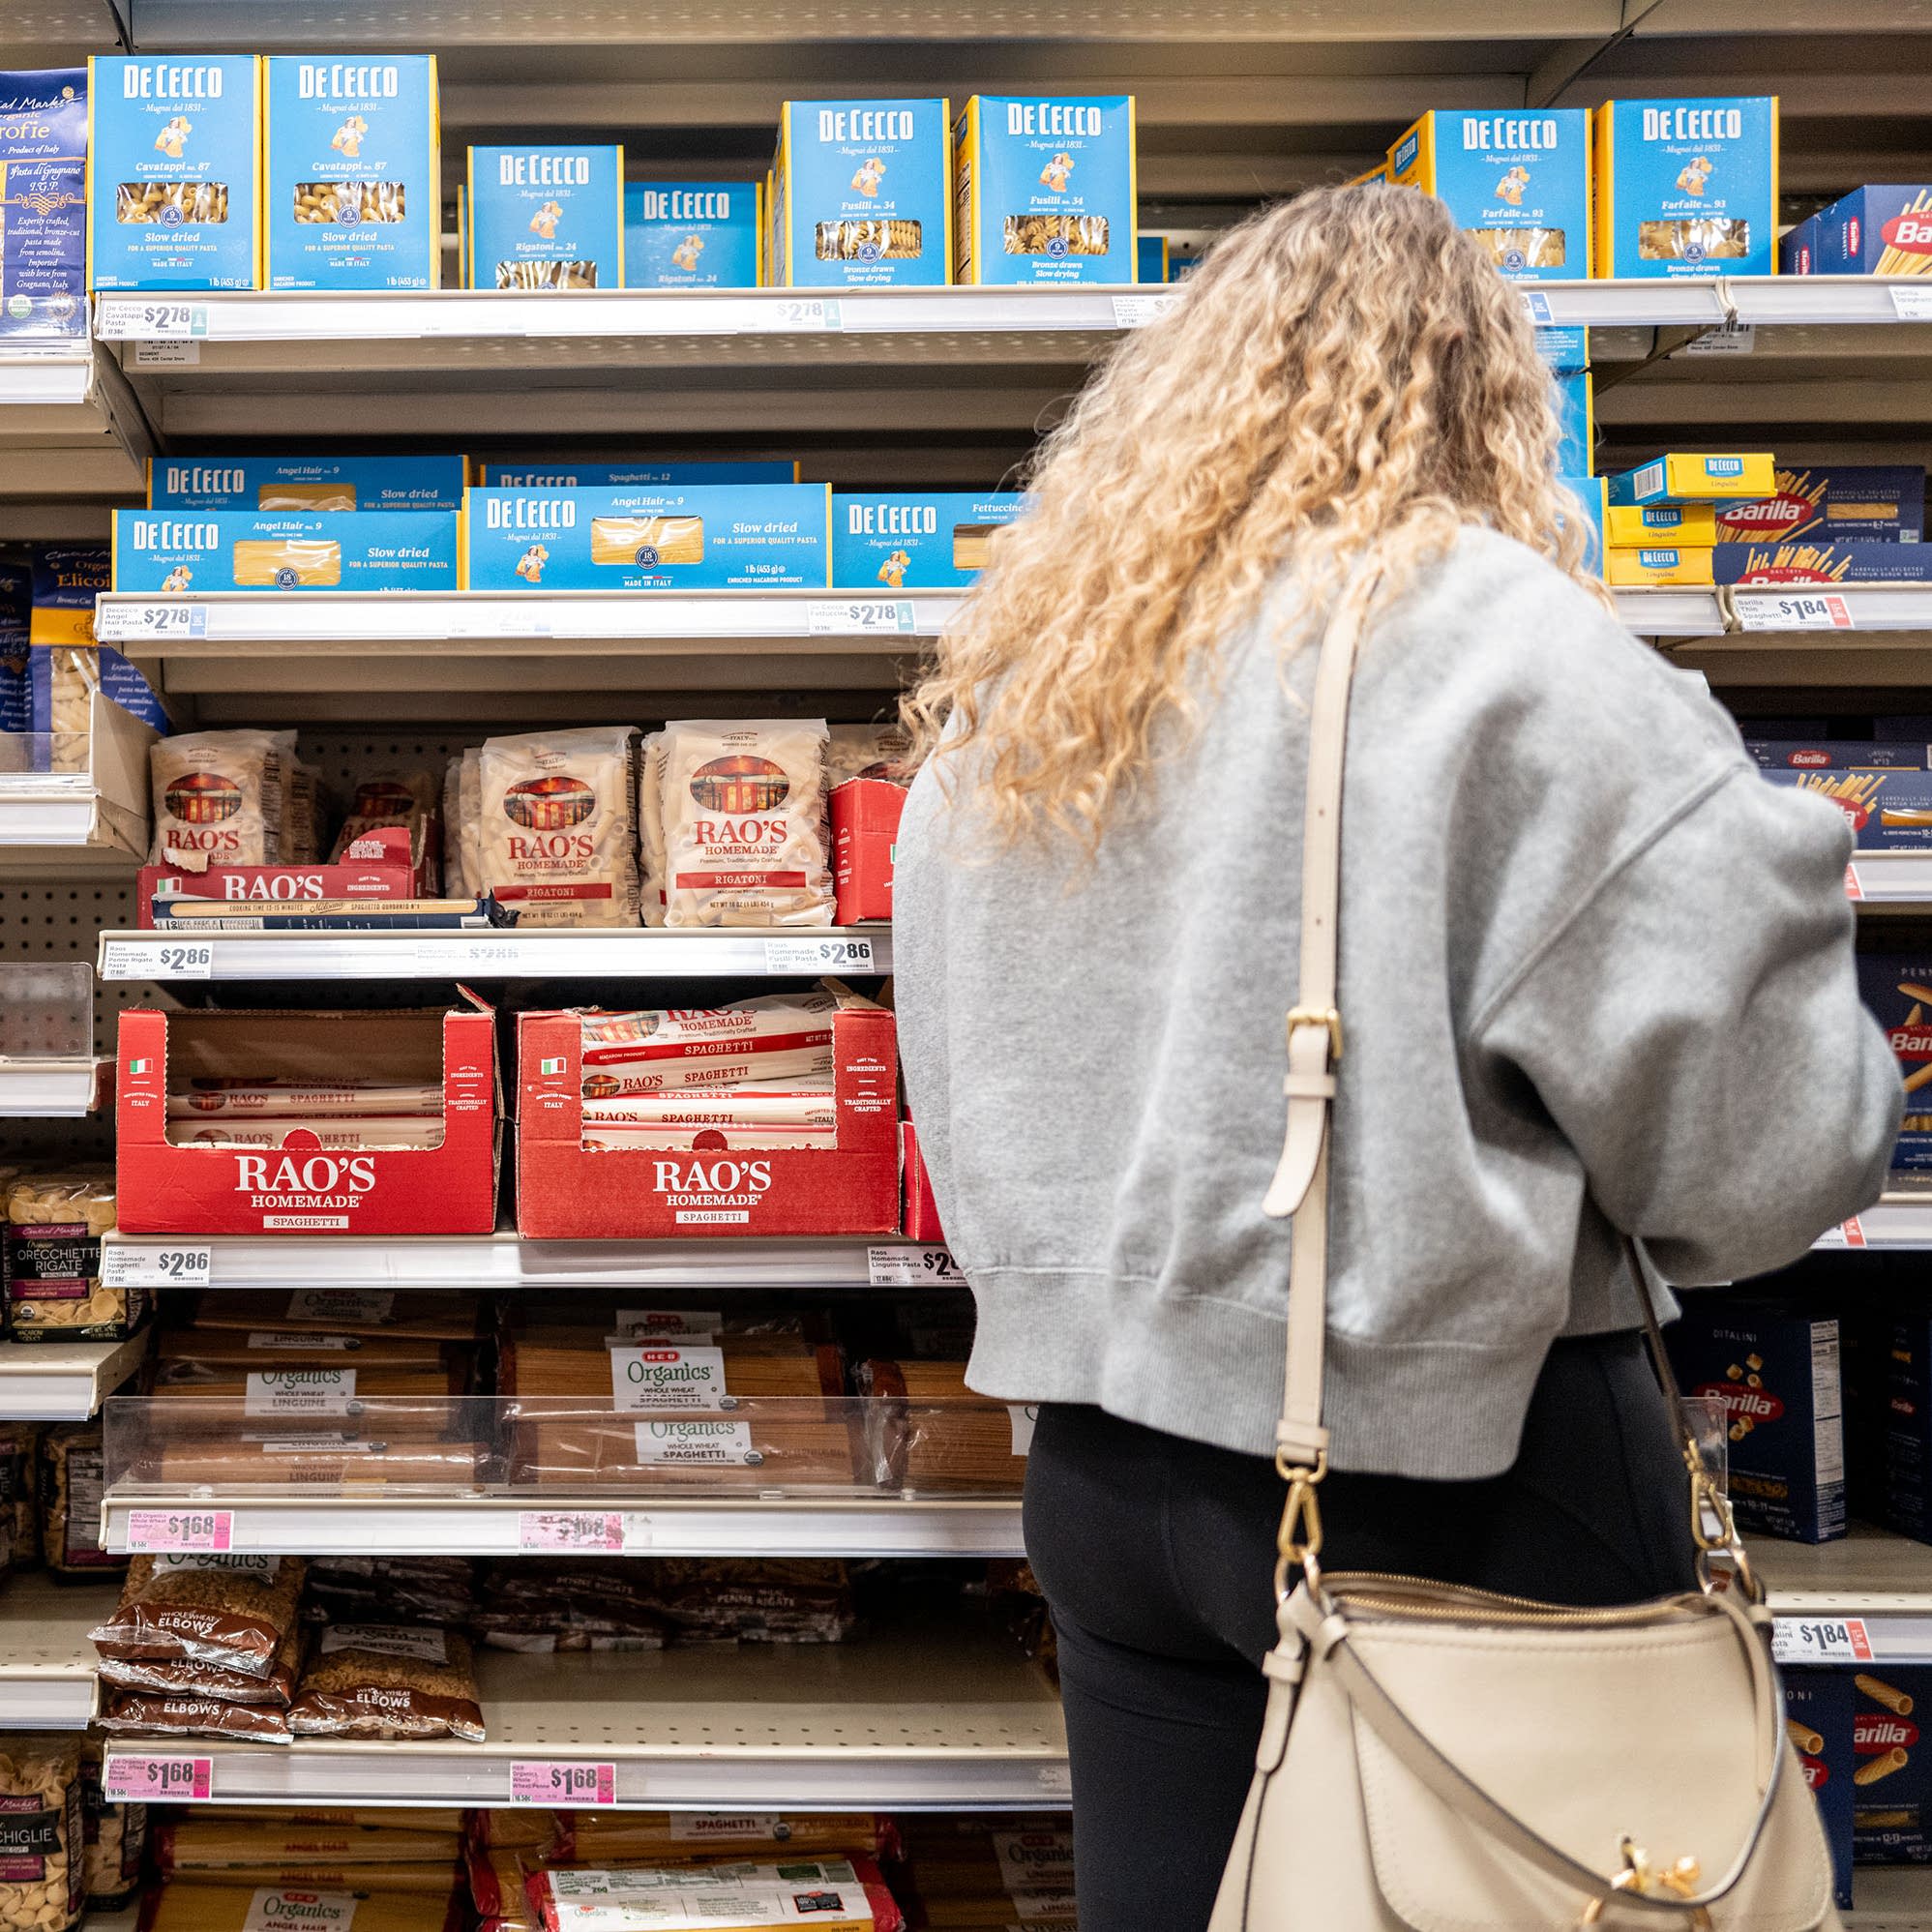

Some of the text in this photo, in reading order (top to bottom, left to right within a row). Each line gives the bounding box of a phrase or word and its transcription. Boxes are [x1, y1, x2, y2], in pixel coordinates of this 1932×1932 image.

[123, 64, 223, 99] DE CECCO
[299, 64, 399, 99] DE CECCO
[1007, 103, 1102, 136] DE CECCO
[1643, 107, 1741, 142] DE CECCO
[819, 109, 914, 143] DE CECCO
[1463, 118, 1558, 150] DE CECCO
[8, 144, 60, 155] Product of Italy
[1030, 139, 1083, 151] Mugnai dal 1831
[135, 162, 211, 174] Cavatappi 87
[312, 162, 387, 173] Cavatappi 87
[499, 154, 590, 186] DE CECCO
[643, 191, 729, 220] DE CECCO
[841, 199, 895, 212] Fusilli 34
[1030, 194, 1084, 205] Fusilli 34
[1661, 199, 1726, 211] Farfalle 93
[1482, 208, 1544, 219] Farfalle 93
[17, 216, 71, 227] Expertly crafted,
[24, 237, 62, 248] pasta made
[144, 232, 200, 243] Slow dried
[18, 248, 35, 258] from
[515, 241, 577, 253] Rigatoni 24
[28, 258, 58, 268] Imported
[1031, 260, 1083, 270] Bronze drawn
[18, 269, 68, 279] with love from
[1035, 269, 1080, 280] Slow drying
[166, 467, 245, 494] DE CECCO
[609, 472, 670, 484] Spaghetti 12
[611, 496, 684, 508] Angel Hair 9
[487, 497, 577, 529] DE CECCO
[848, 504, 937, 534] DE CECCO
[253, 520, 322, 532] Angel Hair 9
[732, 521, 798, 533] Slow dried
[134, 520, 220, 550] DE CECCO
[767, 536, 795, 545] QUALITY
[368, 547, 430, 558] Slow dried
[1643, 550, 1675, 563] DE CECCO
[1792, 754, 1828, 765] Barilla
[693, 819, 788, 845] RAO'S
[507, 835, 594, 860] RAO'S
[704, 845, 778, 855] HOMEMADE
[518, 859, 584, 871] HOMEMADE
[715, 874, 767, 884] RIGATONI
[223, 874, 324, 900] RAO'S
[526, 887, 575, 898] RIGATONI
[679, 1017, 753, 1031] HOMEMADE
[684, 1040, 755, 1056] SPAGHETTI
[684, 1065, 749, 1084] SPAGHETTI
[623, 1075, 664, 1090] RAO'S
[228, 1092, 356, 1104] RAO'S SPAGHETTI
[662, 1114, 733, 1123] SPAGHETTI
[234, 1155, 376, 1193] RAO'S
[652, 1160, 771, 1193] RAO'S
[251, 1195, 359, 1208] HOMEMADE
[666, 1194, 758, 1205] HOMEMADE
[273, 1217, 341, 1227] SPAGHETTI
[683, 1212, 742, 1222] SPAGHETTI
[17, 1247, 101, 1261] ORECCHIETTE
[36, 1260, 83, 1271] RIGATE
[1713, 1328, 1757, 1343] DITALINI
[628, 1361, 711, 1387] Organics
[663, 1449, 726, 1459] SPAGHETTI
[158, 1618, 214, 1633] ELBOWS
[356, 1693, 411, 1709] ELBOWS
[163, 1702, 221, 1715] ELBOWS
[1855, 1724, 1907, 1743] arilla
[696, 1819, 756, 1830] SPAGHETTI
[263, 1894, 341, 1921] Organics
